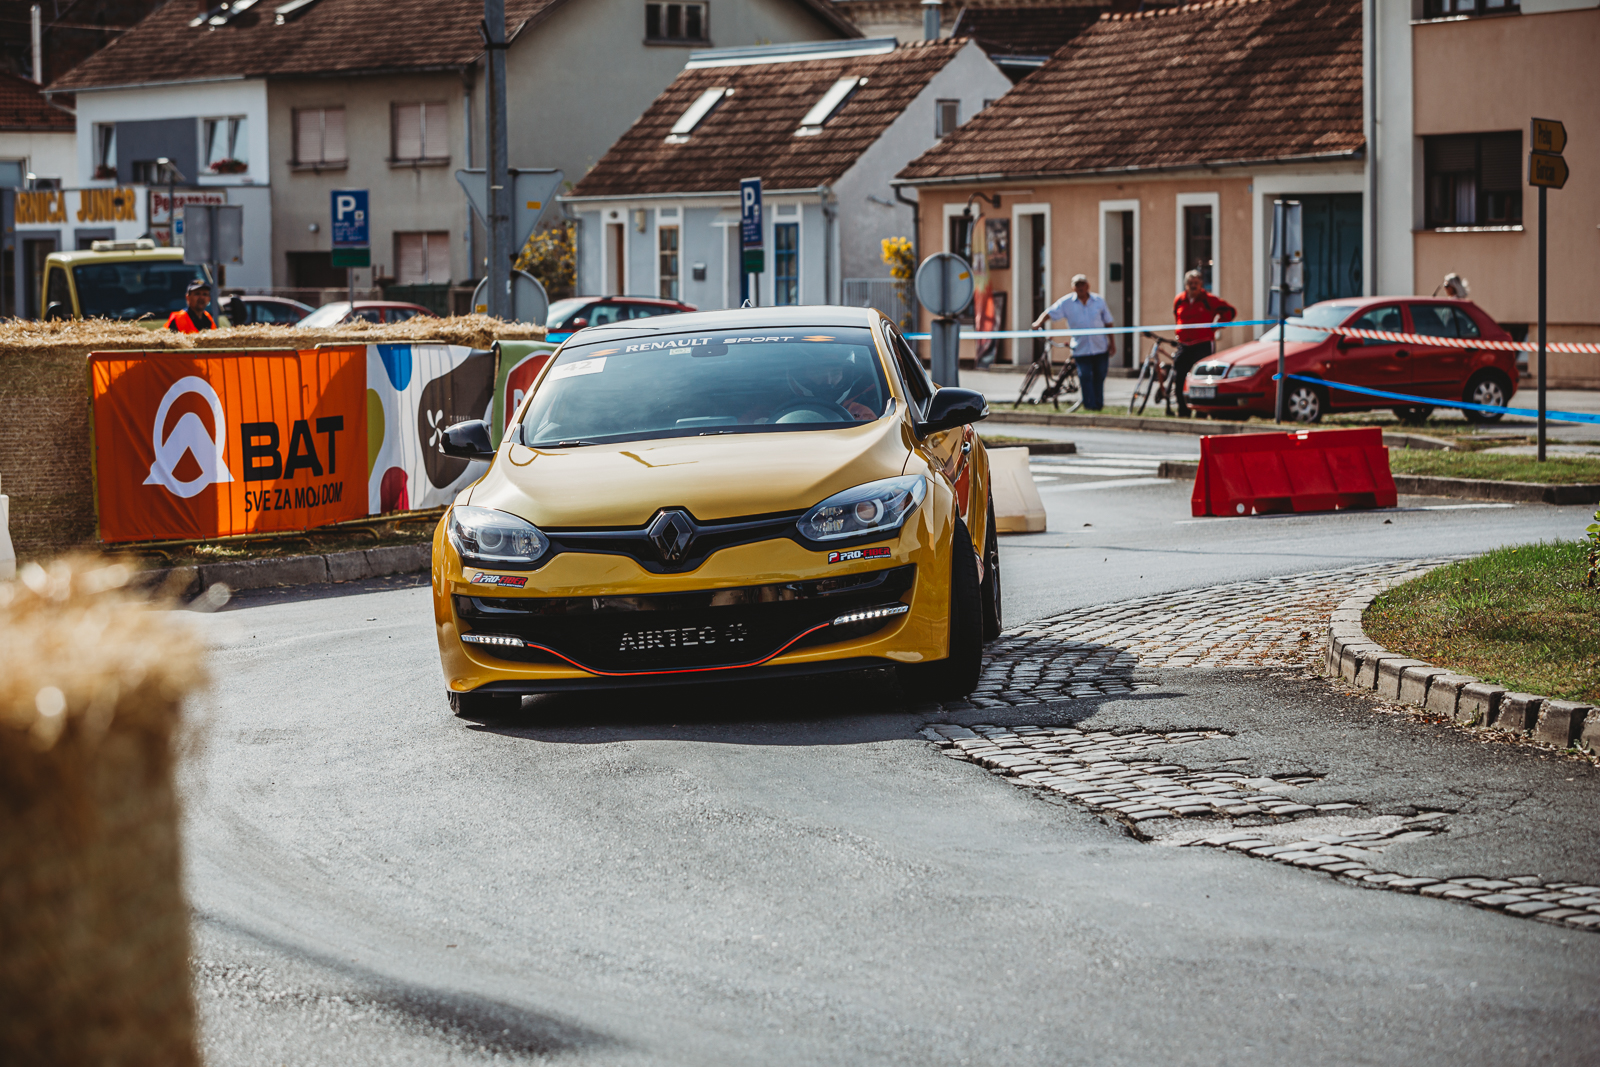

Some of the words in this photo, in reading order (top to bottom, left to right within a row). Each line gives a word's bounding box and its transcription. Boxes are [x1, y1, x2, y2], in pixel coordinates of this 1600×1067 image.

[77, 187, 137, 222] JUNIOR
[336, 194, 357, 221] P
[743, 186, 756, 217] P
[625, 337, 713, 353] RENAULT
[722, 336, 795, 344] SPORT
[563, 360, 593, 372] 42
[240, 415, 344, 482] BAT
[244, 490, 271, 513] SVE
[274, 488, 292, 510] ZA
[294, 486, 321, 509] MOJ
[322, 481, 343, 505] DOM
[840, 547, 890, 561] PRO-FIBER
[480, 575, 527, 586] PRO-FIBER
[619, 626, 716, 651] AIRTEC
